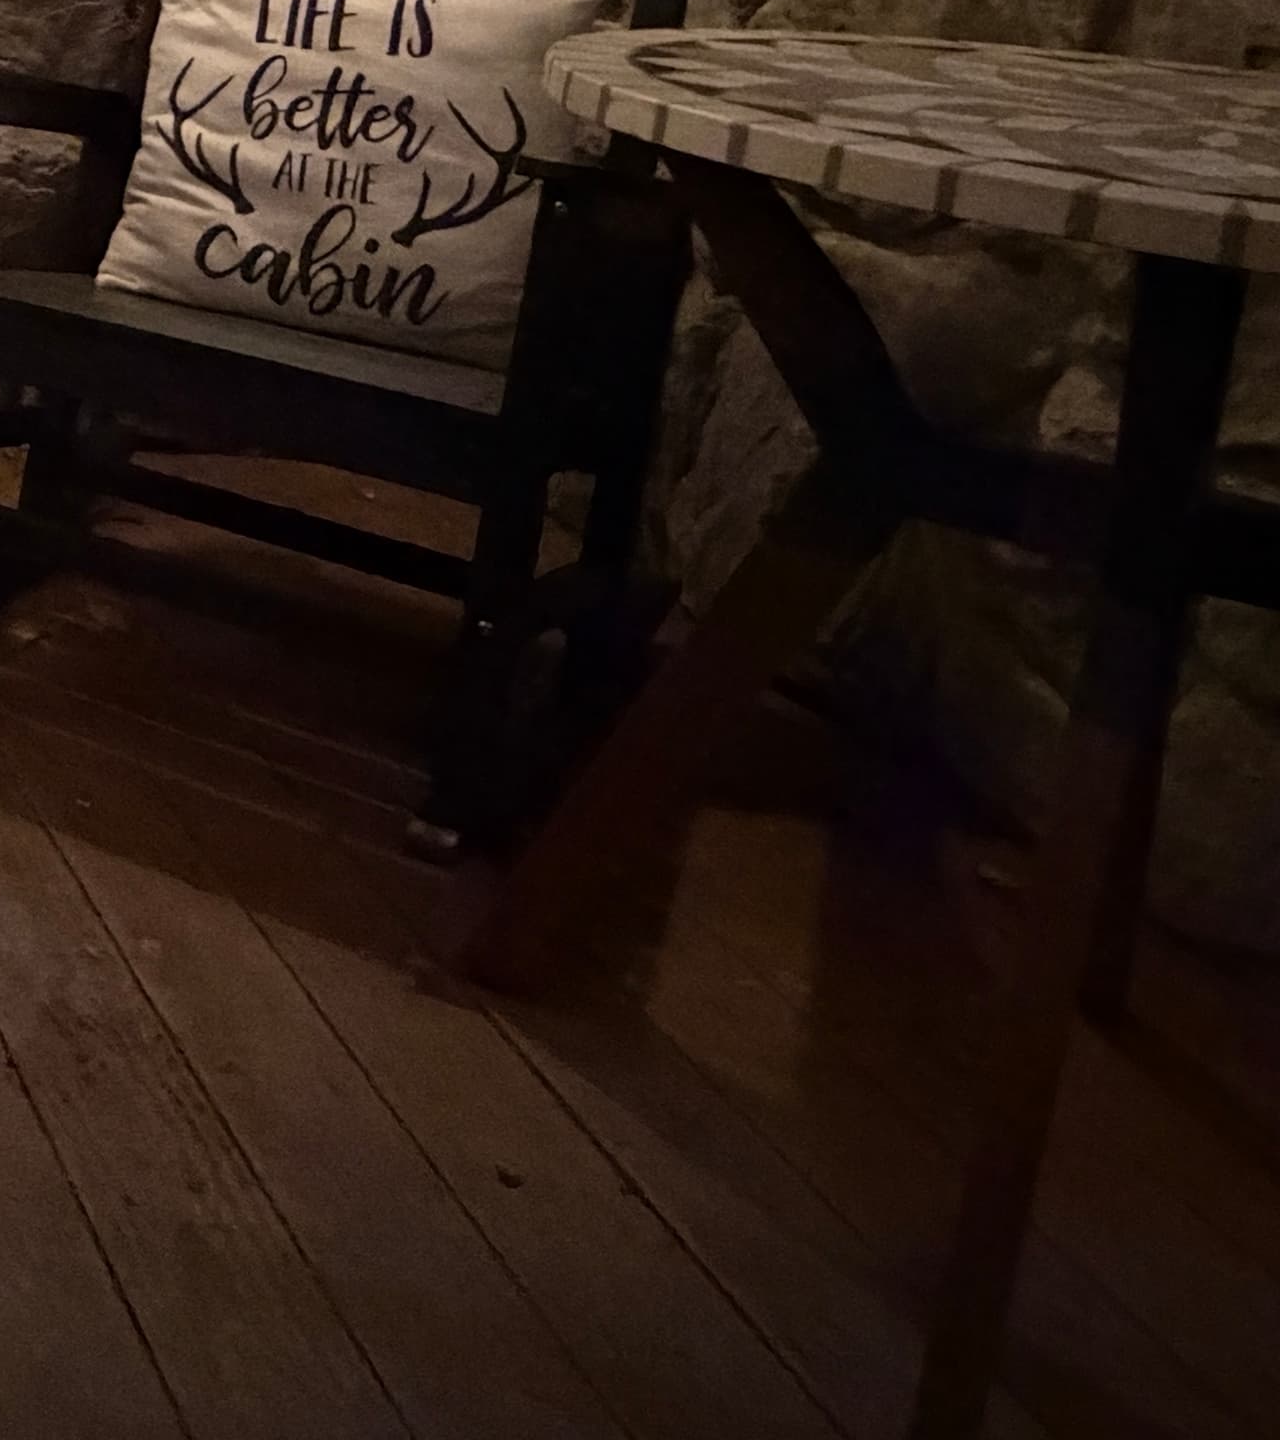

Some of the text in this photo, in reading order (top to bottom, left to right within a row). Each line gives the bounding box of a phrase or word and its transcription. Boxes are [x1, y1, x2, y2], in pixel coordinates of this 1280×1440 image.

[243, 54, 435, 163] better
[271, 150, 381, 205] AT THE
[194, 204, 450, 326] cabin
